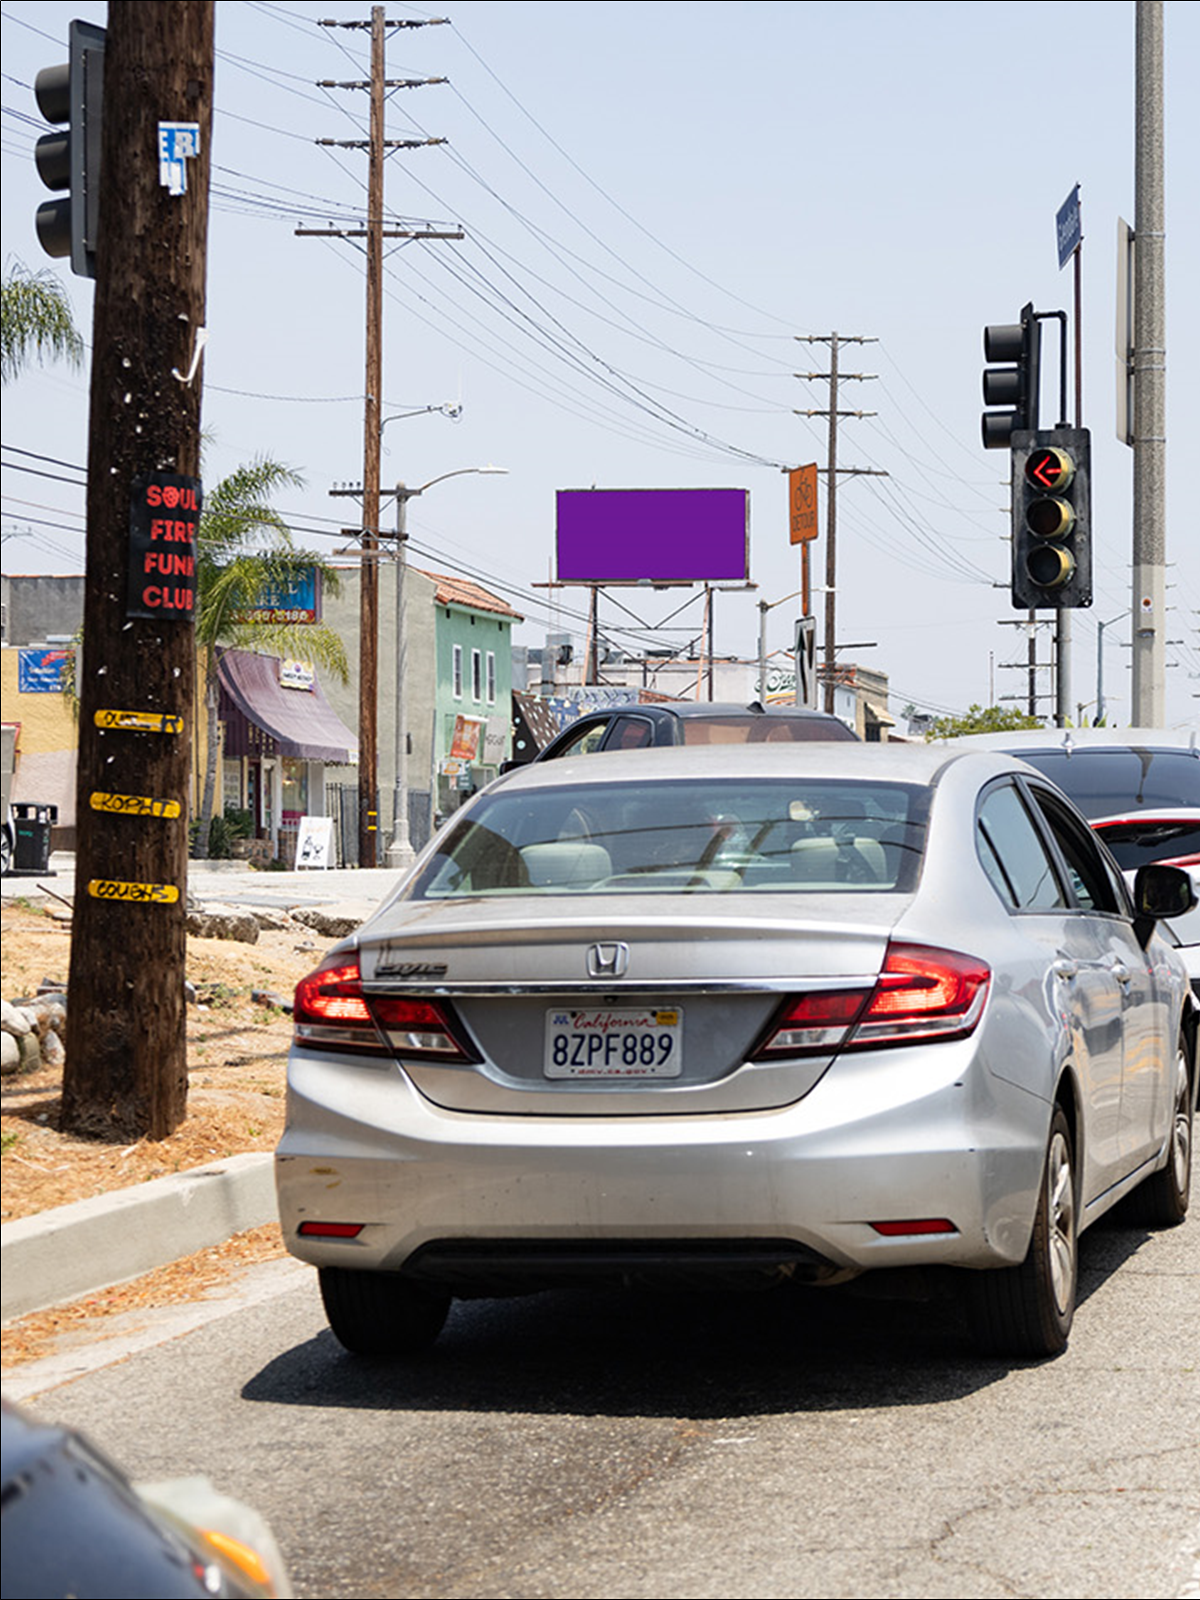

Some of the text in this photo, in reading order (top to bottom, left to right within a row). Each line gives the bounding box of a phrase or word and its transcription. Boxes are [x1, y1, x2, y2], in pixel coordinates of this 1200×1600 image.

[146, 484, 198, 511] SOUL
[150, 518, 195, 544] FIRE
[142, 585, 194, 610] CLUB
[375, 962, 448, 979] CIVIC
[573, 1011, 659, 1034] California
[553, 1033, 674, 1067] 8ZPF889
